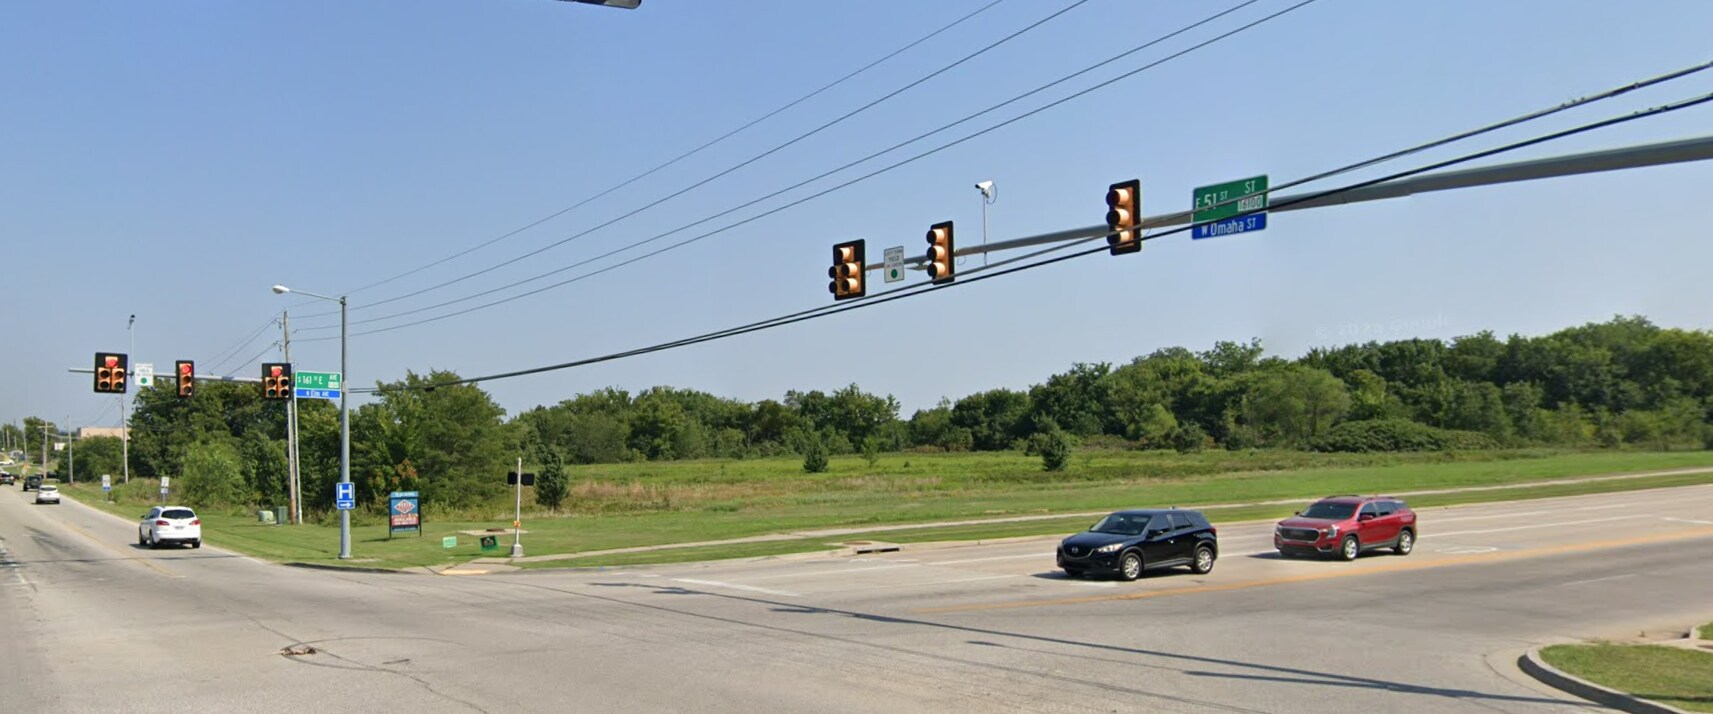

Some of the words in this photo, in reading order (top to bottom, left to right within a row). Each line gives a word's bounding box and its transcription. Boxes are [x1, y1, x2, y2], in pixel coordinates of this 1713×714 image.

[1196, 197, 1202, 210] E
[1204, 193, 1217, 210] 51
[1220, 190, 1228, 200] ST
[1244, 180, 1256, 194] ST
[1201, 225, 1208, 236] W
[1210, 220, 1244, 236] Omaha
[1247, 217, 1257, 229] ST
[302, 375, 312, 384] 161
[338, 484, 352, 499] H
